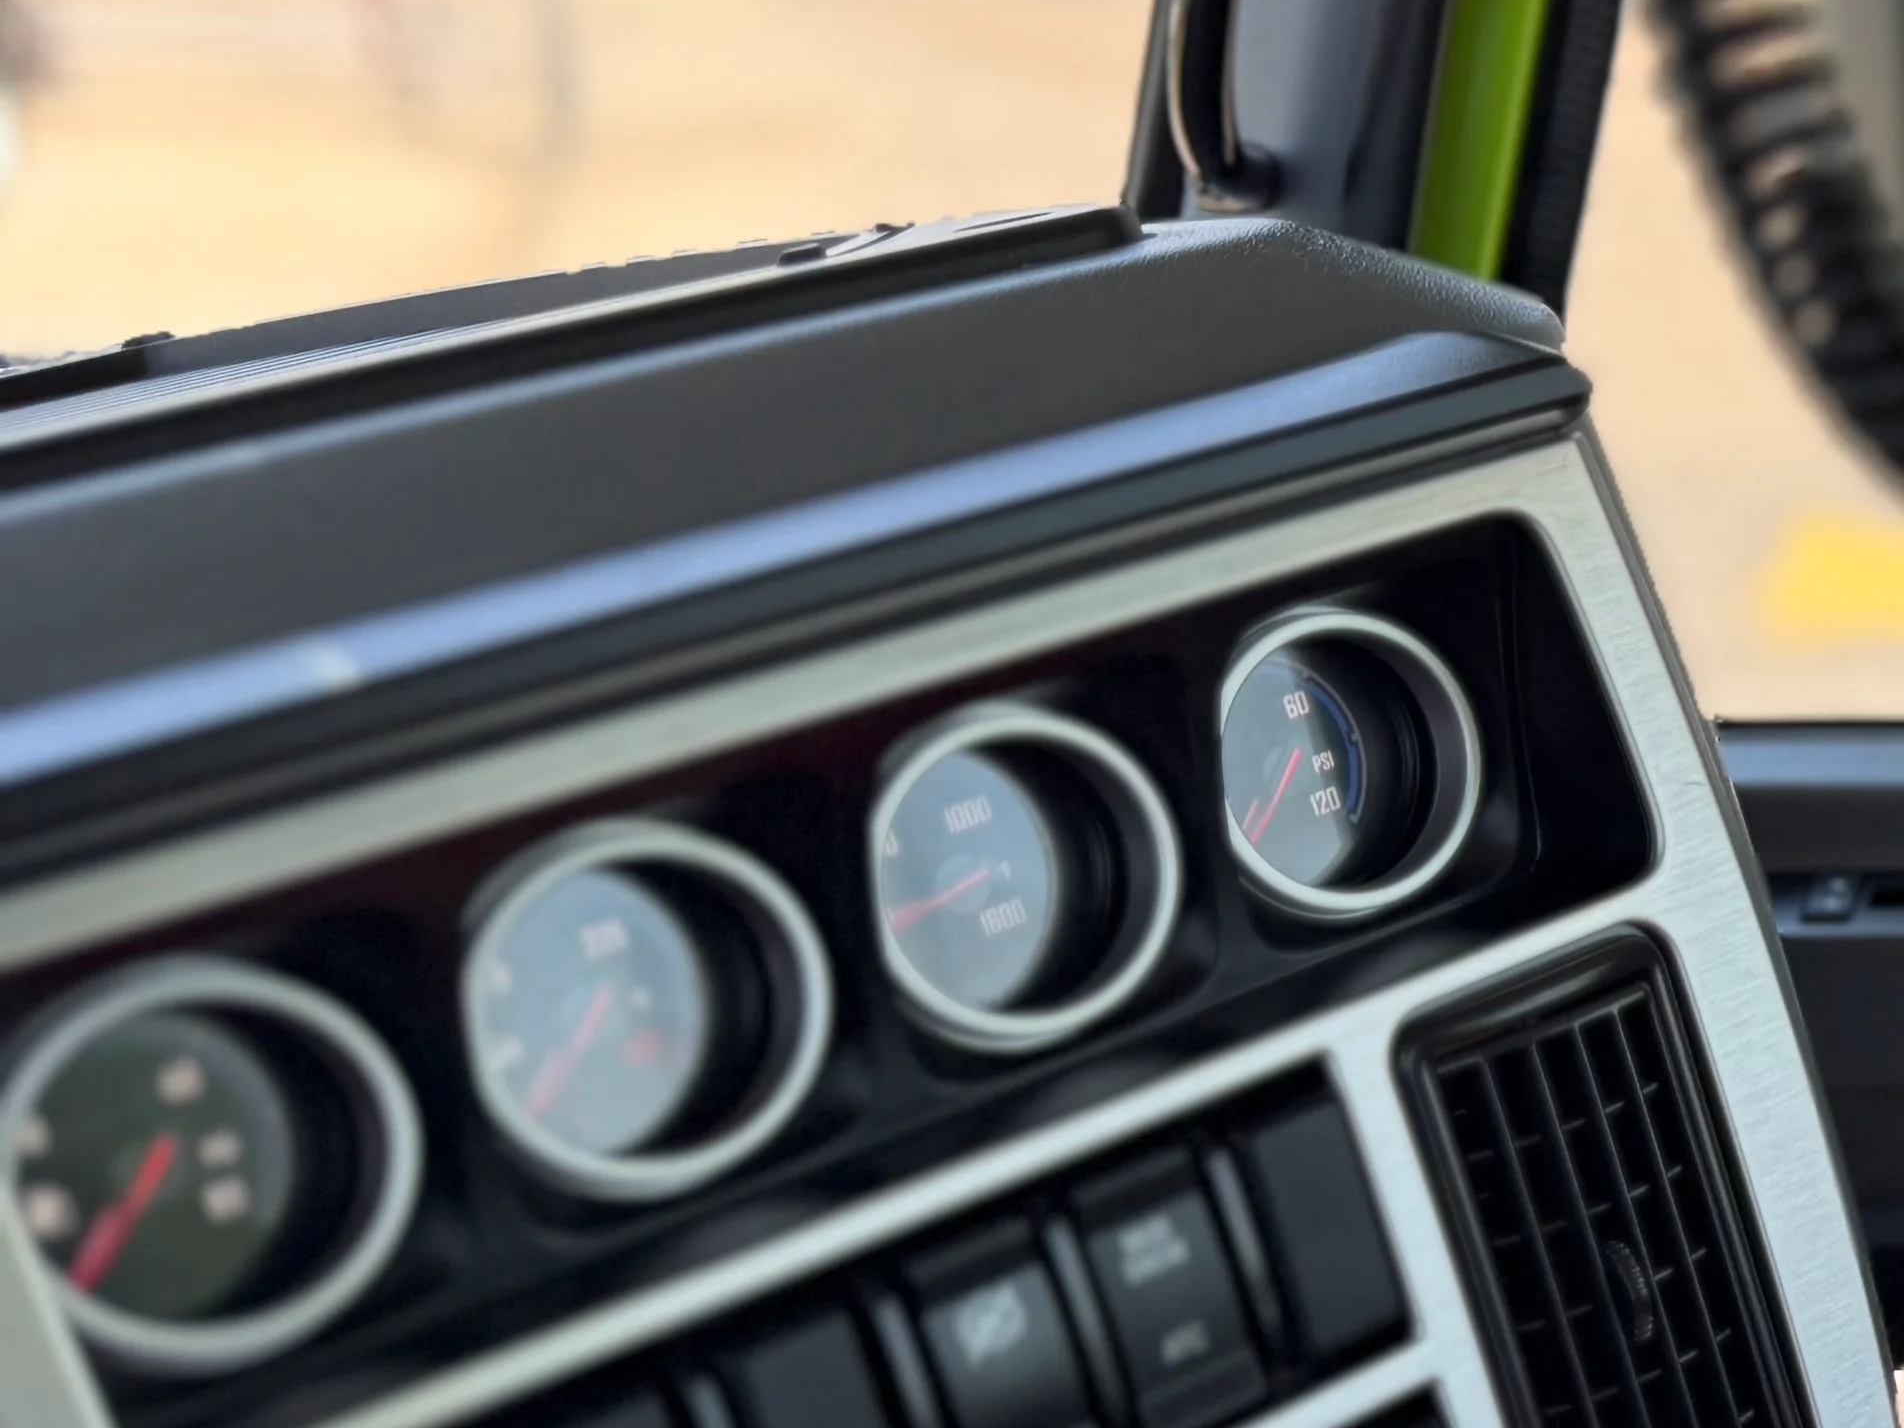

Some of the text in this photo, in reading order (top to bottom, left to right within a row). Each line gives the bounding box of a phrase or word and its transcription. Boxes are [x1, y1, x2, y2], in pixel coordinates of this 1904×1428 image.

[1283, 690, 1310, 719] 60
[1312, 750, 1335, 773] PSI
[944, 796, 992, 834] 1000
[1310, 786, 1341, 817] 120
[979, 899, 1028, 939] 1600
